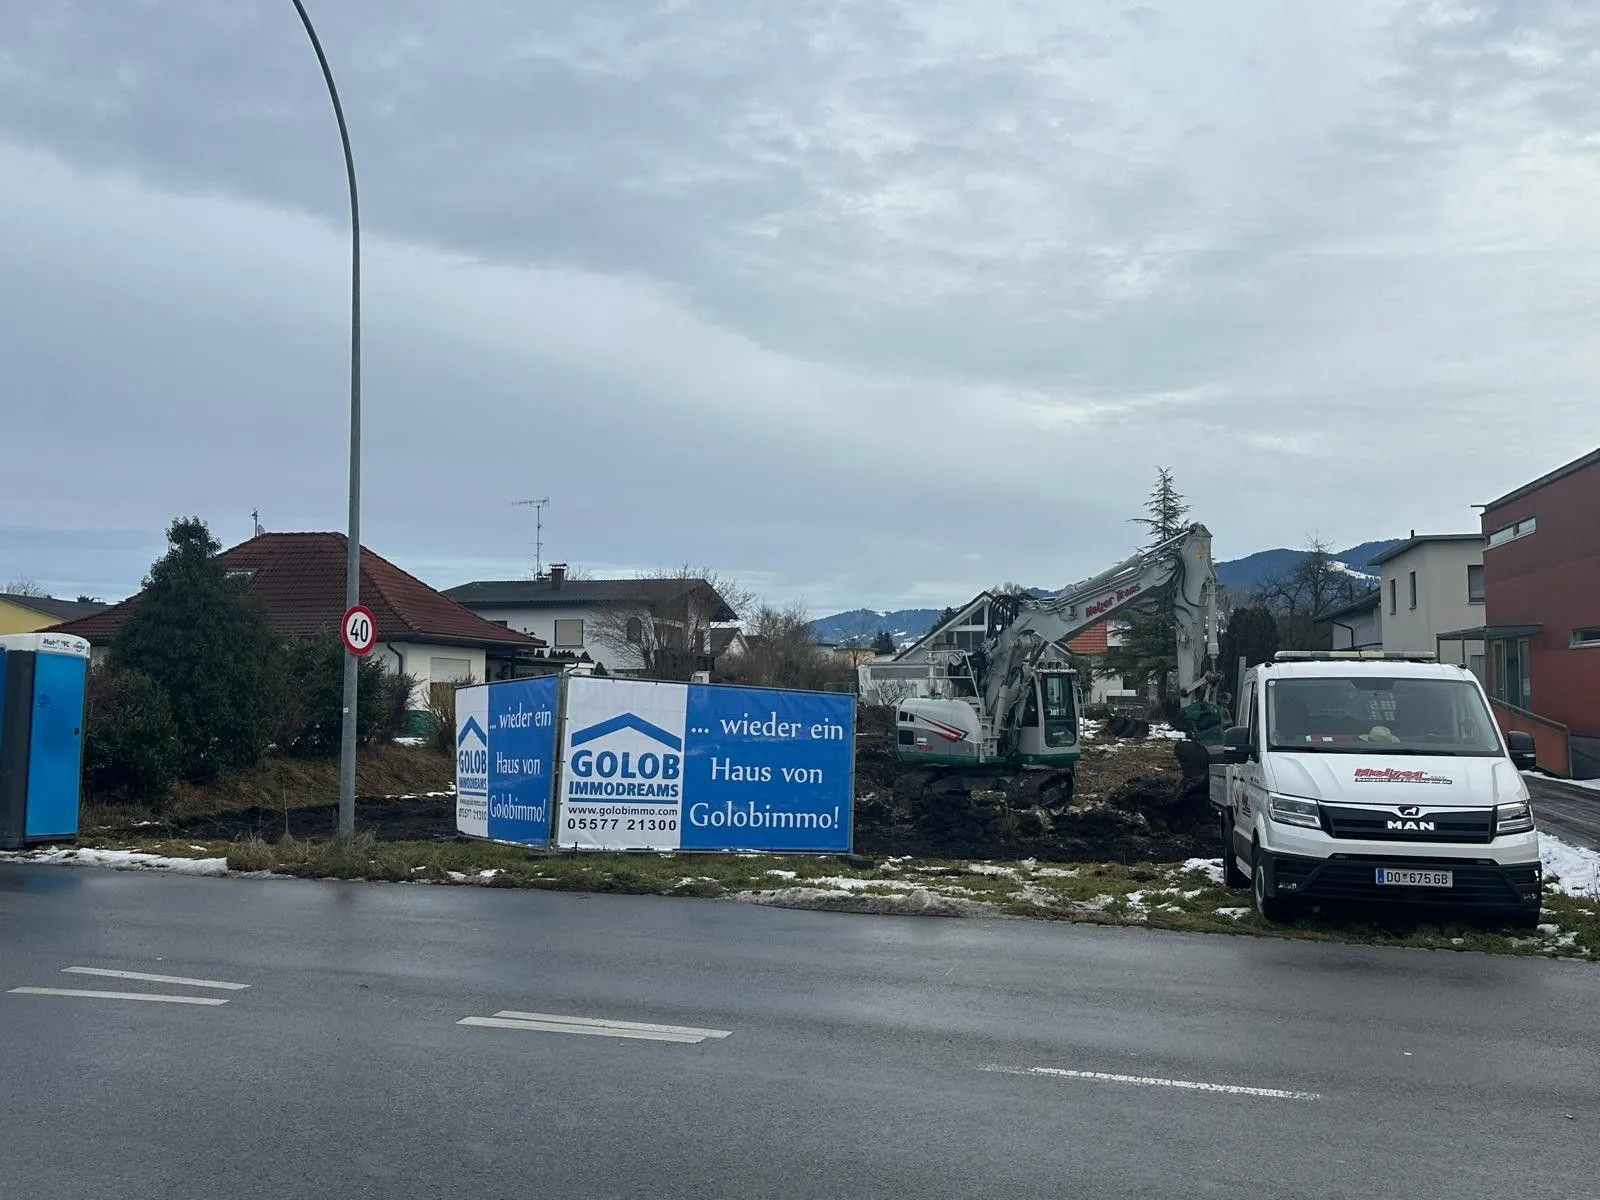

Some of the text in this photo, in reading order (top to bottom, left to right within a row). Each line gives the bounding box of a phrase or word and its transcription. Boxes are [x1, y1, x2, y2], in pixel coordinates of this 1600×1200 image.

[350, 618, 368, 642] 40
[499, 702, 532, 729] wieder
[535, 703, 551, 728] ein
[720, 711, 801, 738] wieder
[810, 717, 843, 740] ein
[459, 749, 487, 774] GOLOB
[496, 752, 540, 775] Haus von
[570, 749, 680, 780] GOLOB
[710, 756, 823, 784] Haus von
[569, 781, 679, 797] IMMODREAMS
[489, 793, 547, 823] Golobimmo!
[568, 805, 678, 816] www.golobimmo.com
[689, 800, 839, 829] Golobimmo!
[567, 818, 677, 831] 05577 21300
[1387, 820, 1435, 831] MAN
